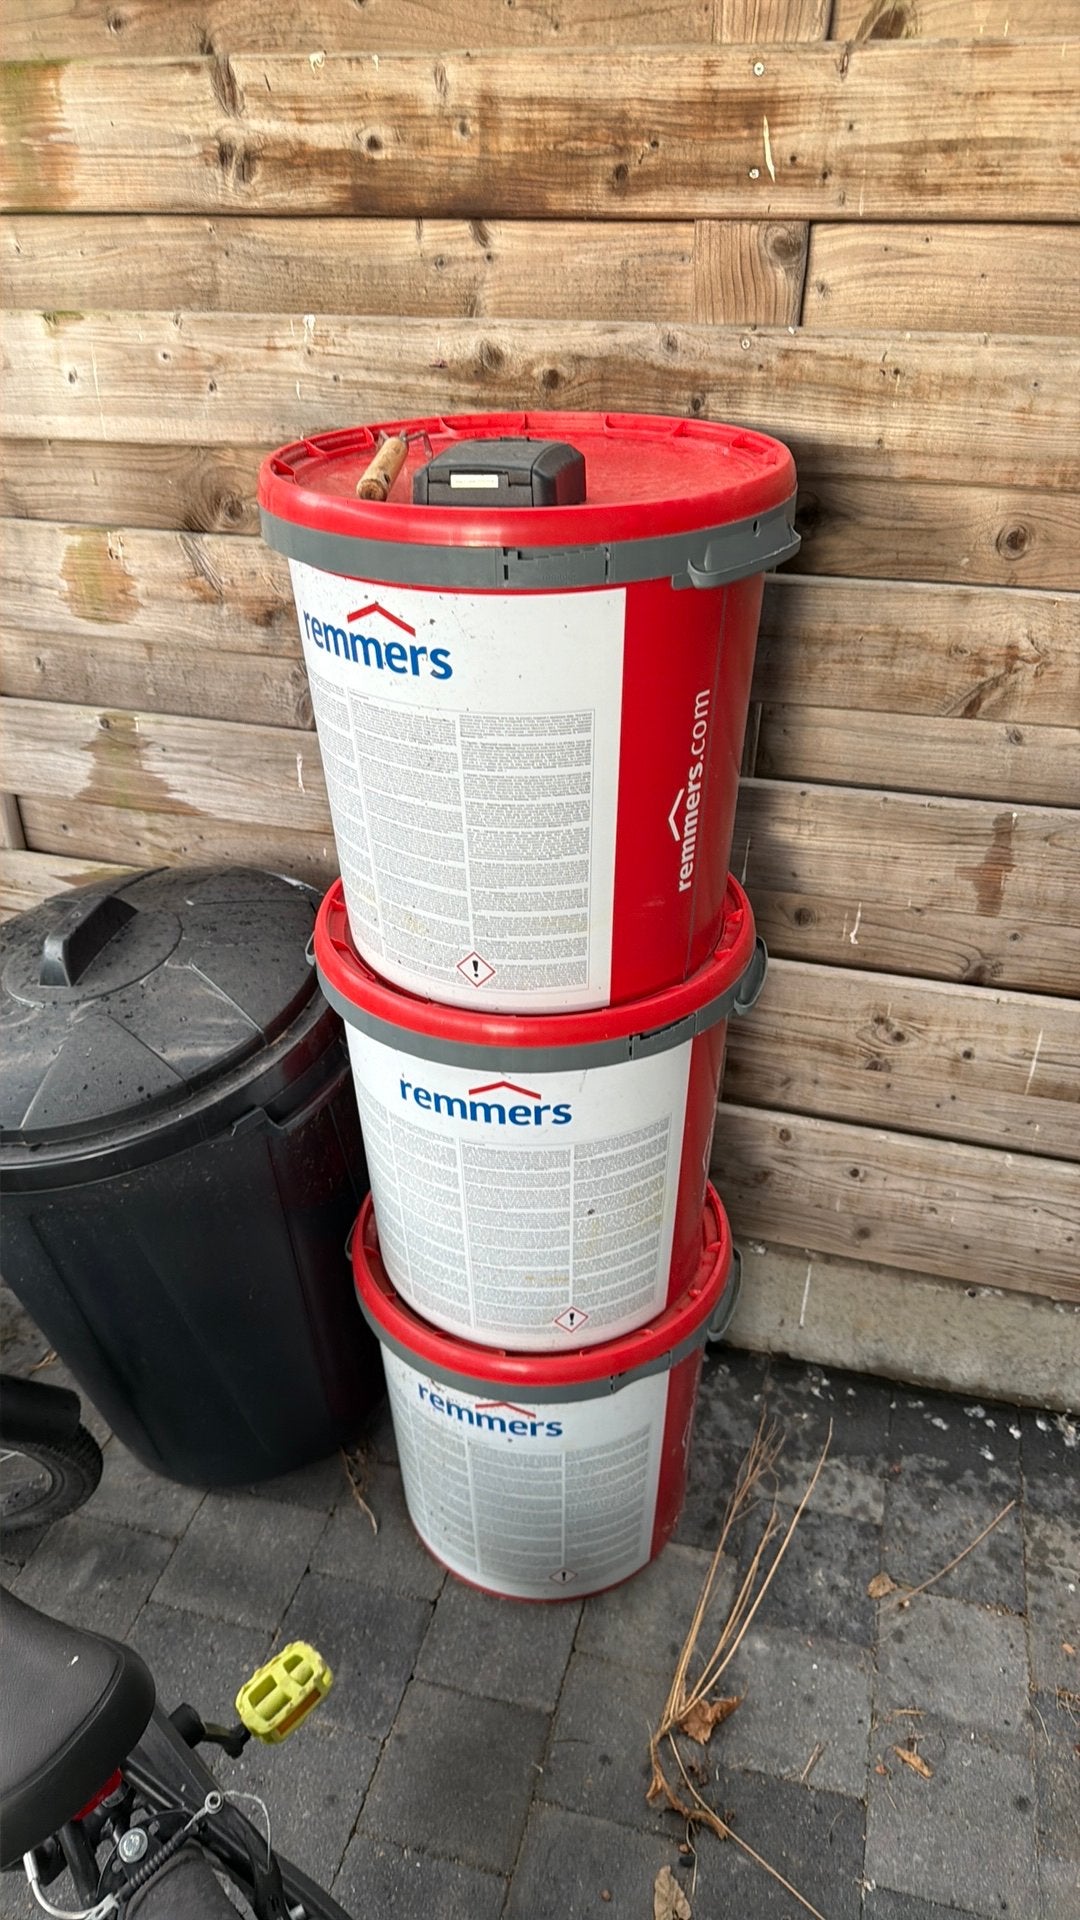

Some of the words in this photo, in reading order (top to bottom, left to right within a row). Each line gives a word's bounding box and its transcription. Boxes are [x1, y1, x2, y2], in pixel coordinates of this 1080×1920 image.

[303, 610, 453, 680] remmers
[679, 689, 711, 893] remmers.com
[400, 1078, 573, 1126] remmers
[418, 1382, 564, 1437] remmers
